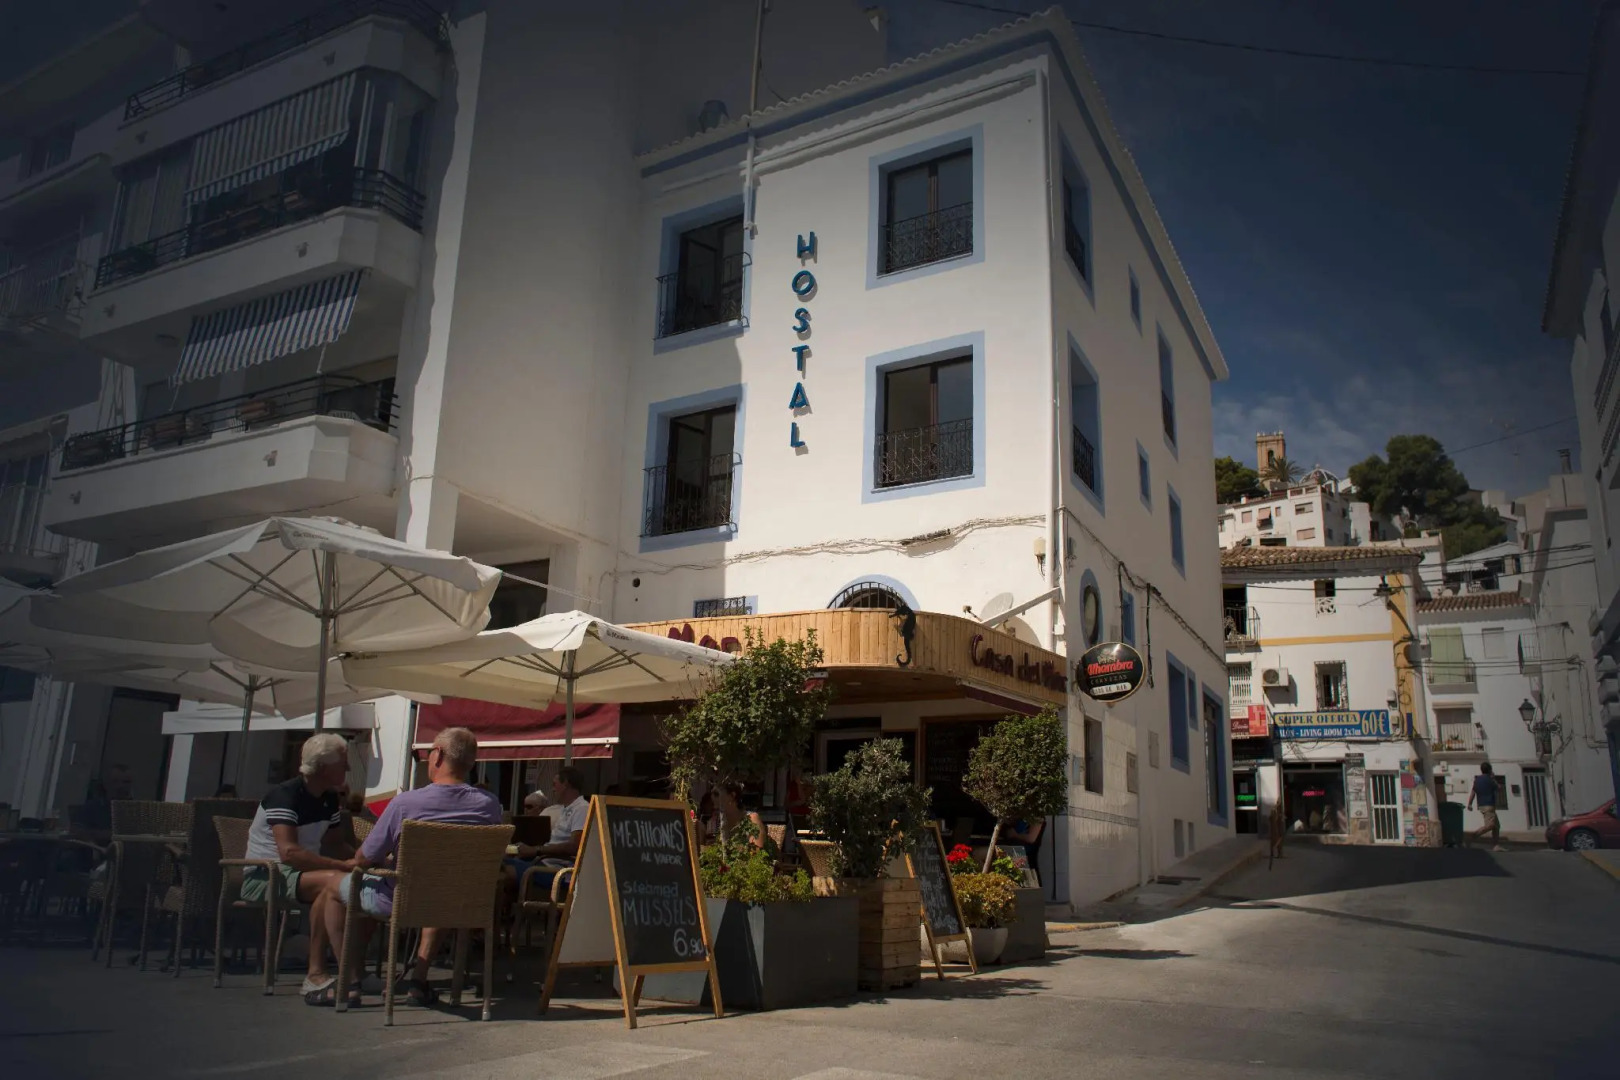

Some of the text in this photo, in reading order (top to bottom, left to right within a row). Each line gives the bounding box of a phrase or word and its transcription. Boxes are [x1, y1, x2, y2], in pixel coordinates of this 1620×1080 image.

[788, 231, 816, 448] HOSTAL
[971, 634, 1014, 678] Casa
[1087, 660, 1134, 676] Alhambra
[1278, 713, 1358, 725] SUPER OFERTA
[1361, 711, 1387, 736] 60€
[1299, 727, 1322, 737] LIVING
[1323, 727, 1343, 737] ROOM
[641, 852, 683, 866] AL VAPOR
[623, 895, 697, 928] MUSSELS
